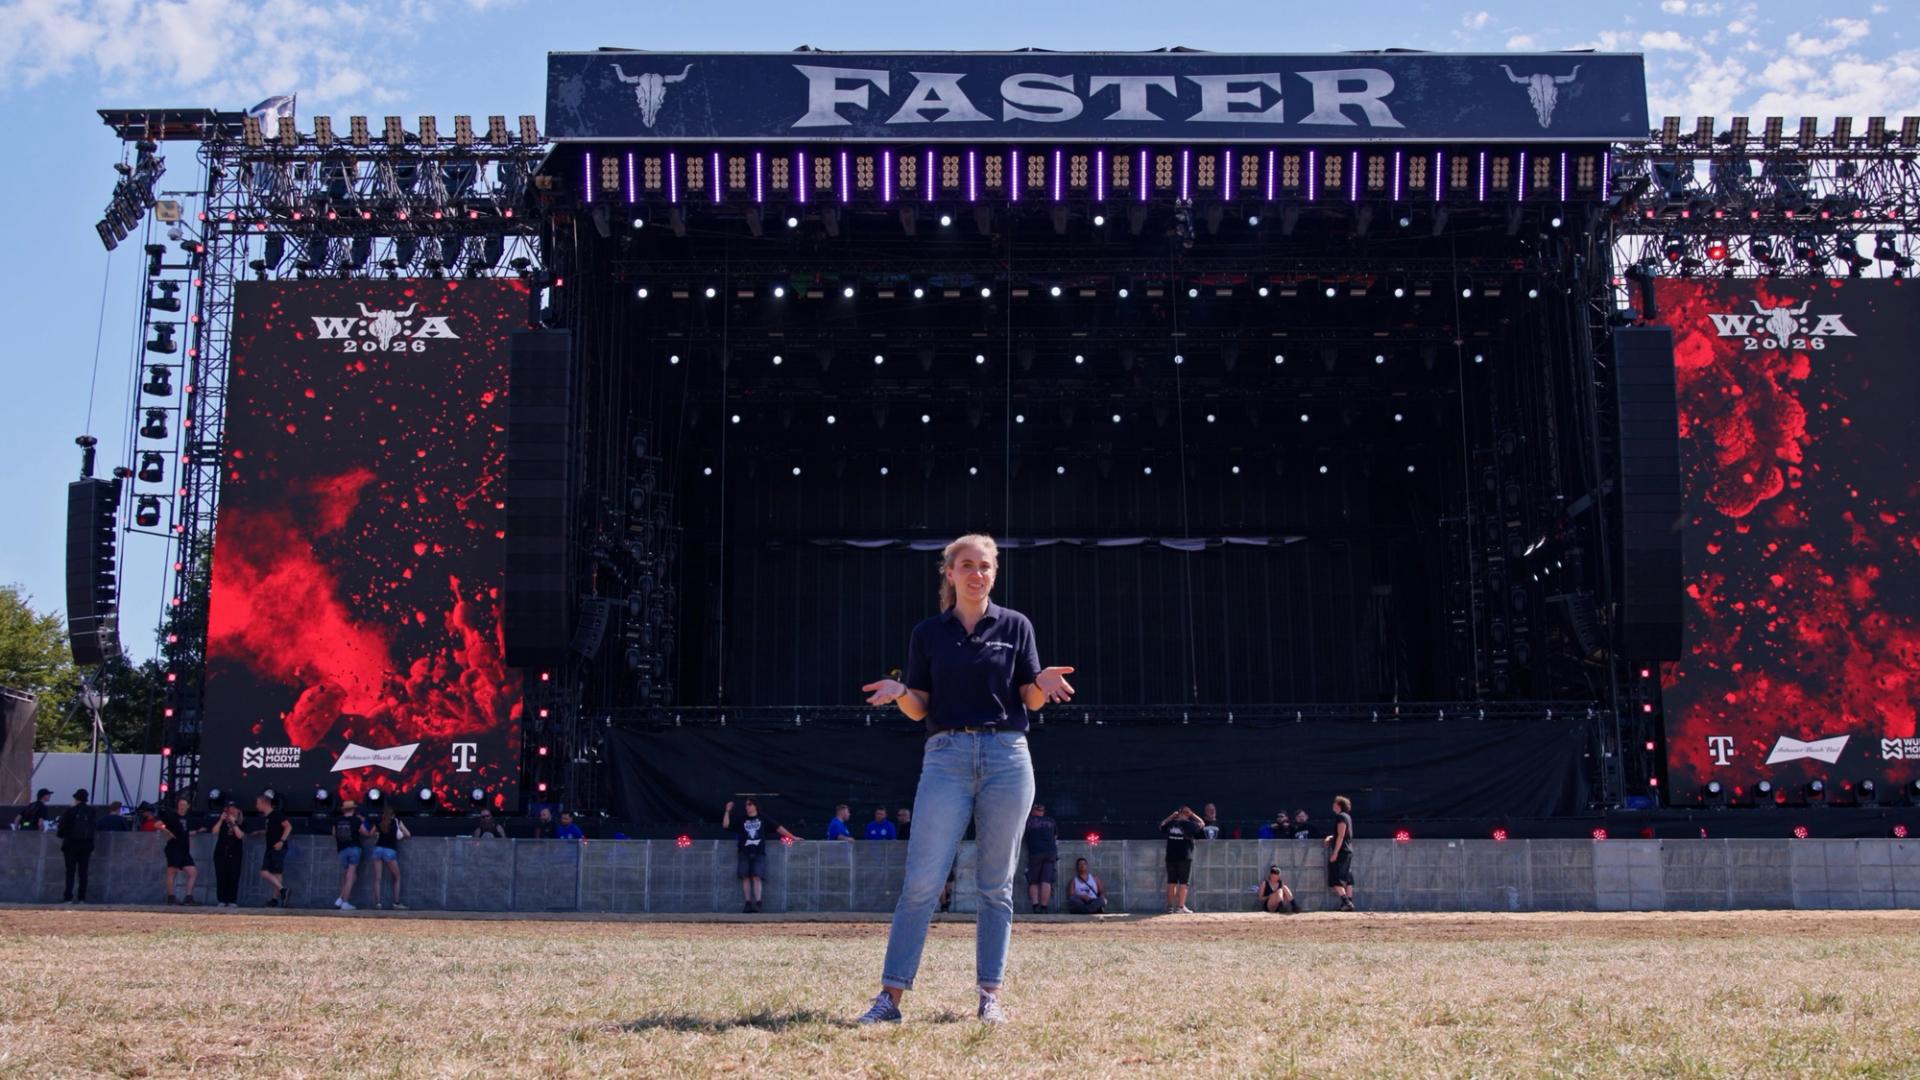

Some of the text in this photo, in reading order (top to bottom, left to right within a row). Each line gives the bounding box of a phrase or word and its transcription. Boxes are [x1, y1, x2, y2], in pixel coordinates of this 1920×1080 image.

[790, 64, 1406, 129] FASTER
[343, 340, 426, 353] 2026
[1743, 337, 1826, 350] 2026
[451, 743, 477, 772] T
[1708, 736, 1734, 765] T
